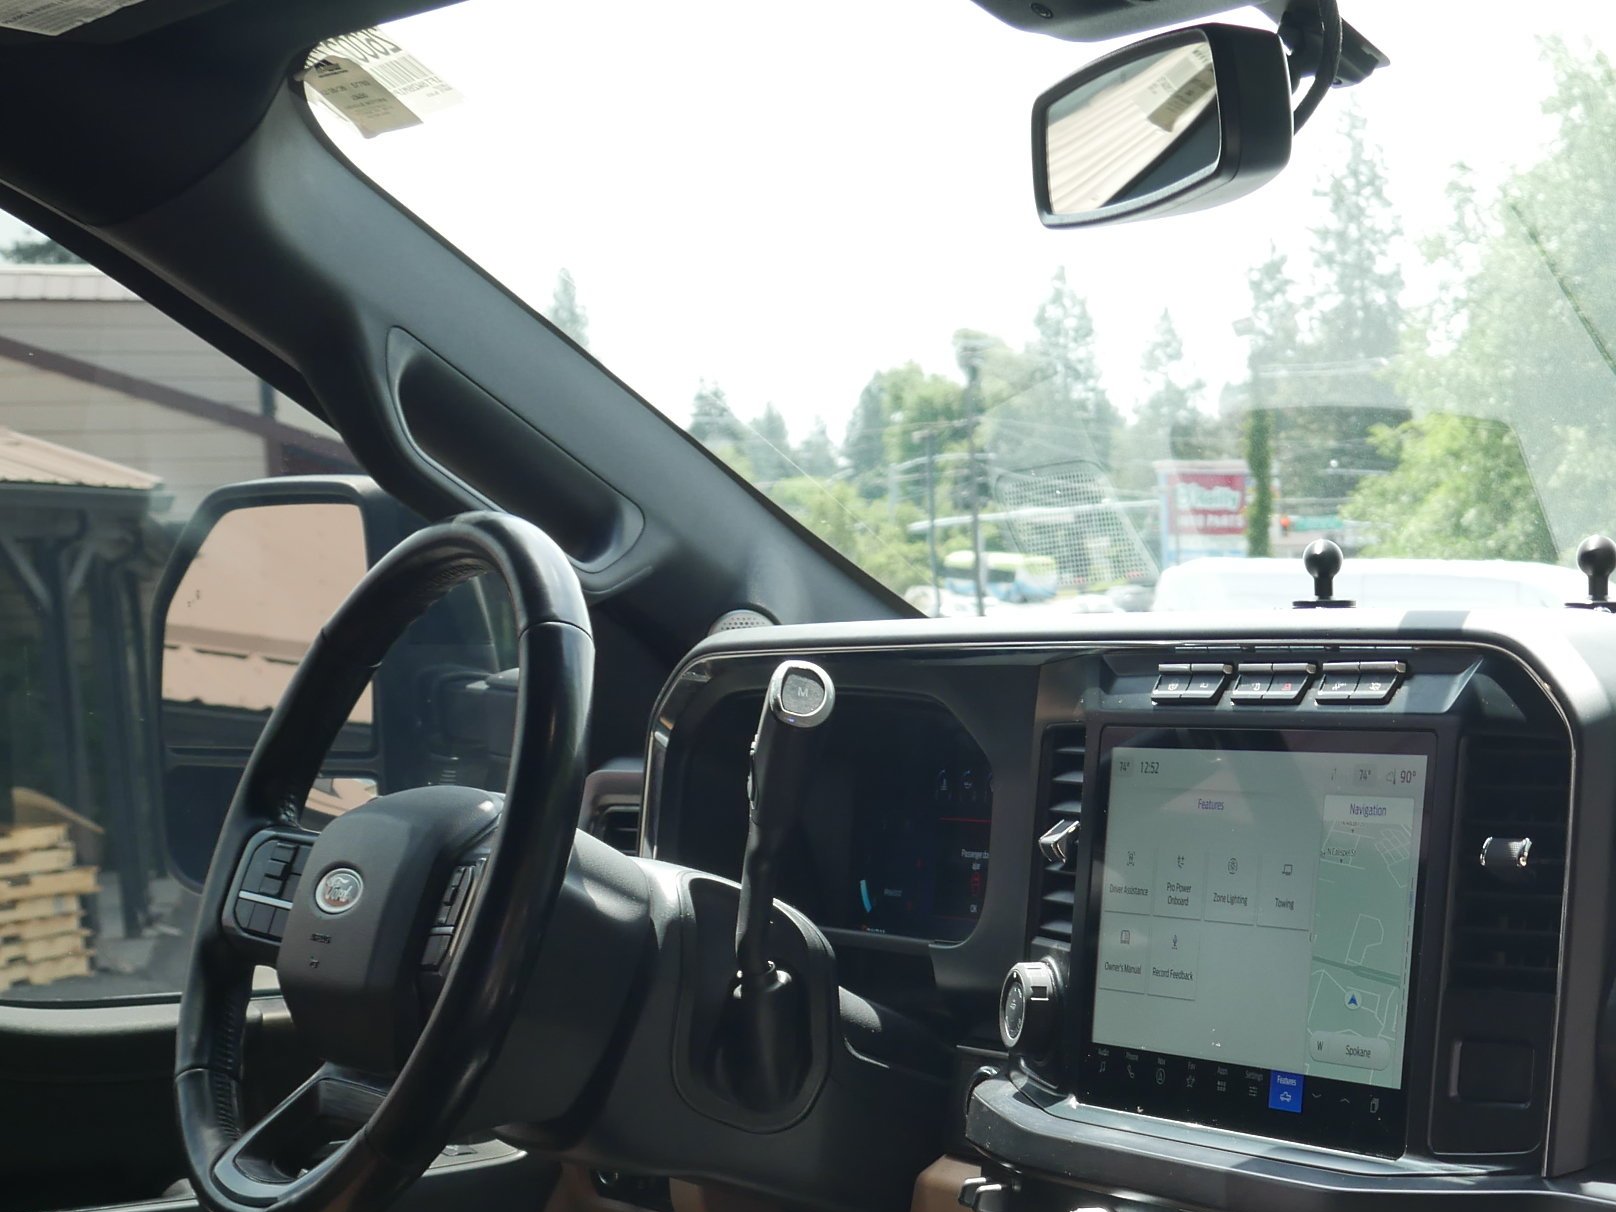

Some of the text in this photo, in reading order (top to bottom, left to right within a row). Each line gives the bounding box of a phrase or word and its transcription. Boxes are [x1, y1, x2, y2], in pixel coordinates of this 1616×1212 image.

[797, 686, 809, 697] M
[1400, 770, 1416, 784] 90°
[1197, 799, 1225, 811] Features
[1350, 803, 1387, 817] Navigation
[1110, 883, 1149, 897] Driver Assistance
[1167, 882, 1192, 894] Pro Power
[1167, 896, 1189, 907] Onboard
[1213, 892, 1248, 907] Zone Lighting
[1275, 898, 1295, 911] Towing
[1104, 961, 1142, 975] Owner's Manual
[1152, 967, 1194, 981] Record Feedback
[1317, 1041, 1324, 1051] W
[1345, 1044, 1371, 1059] Spokane
[1277, 1075, 1297, 1086] Features
